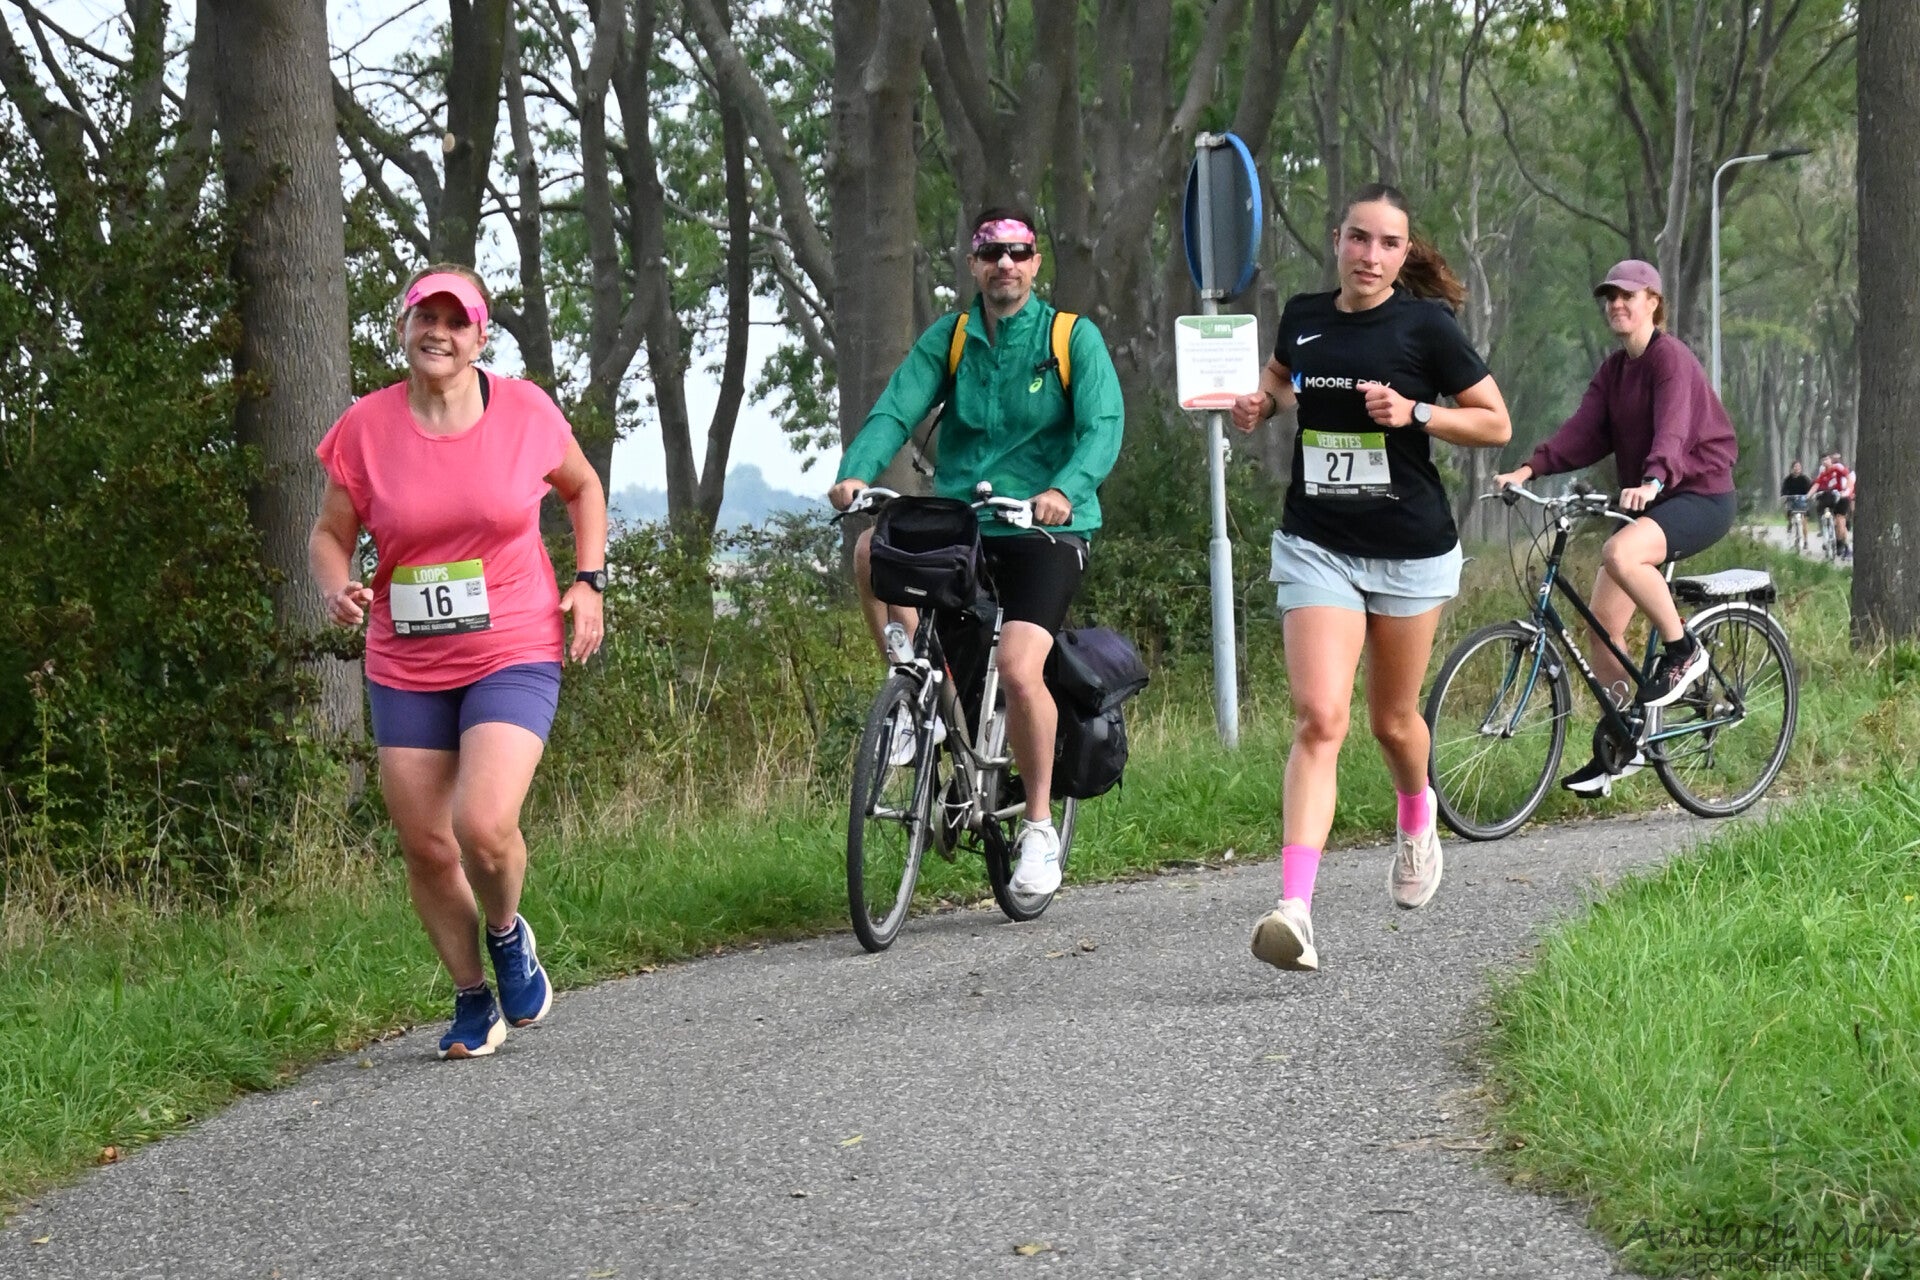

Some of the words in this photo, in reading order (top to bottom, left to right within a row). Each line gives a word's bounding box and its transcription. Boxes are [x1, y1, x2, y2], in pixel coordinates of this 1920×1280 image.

[1305, 377, 1353, 389] MOORE
[1317, 434, 1362, 449] VEDETTES
[1326, 452, 1354, 482] 27
[413, 567, 449, 584] LOOPS
[420, 585, 453, 618] 16
